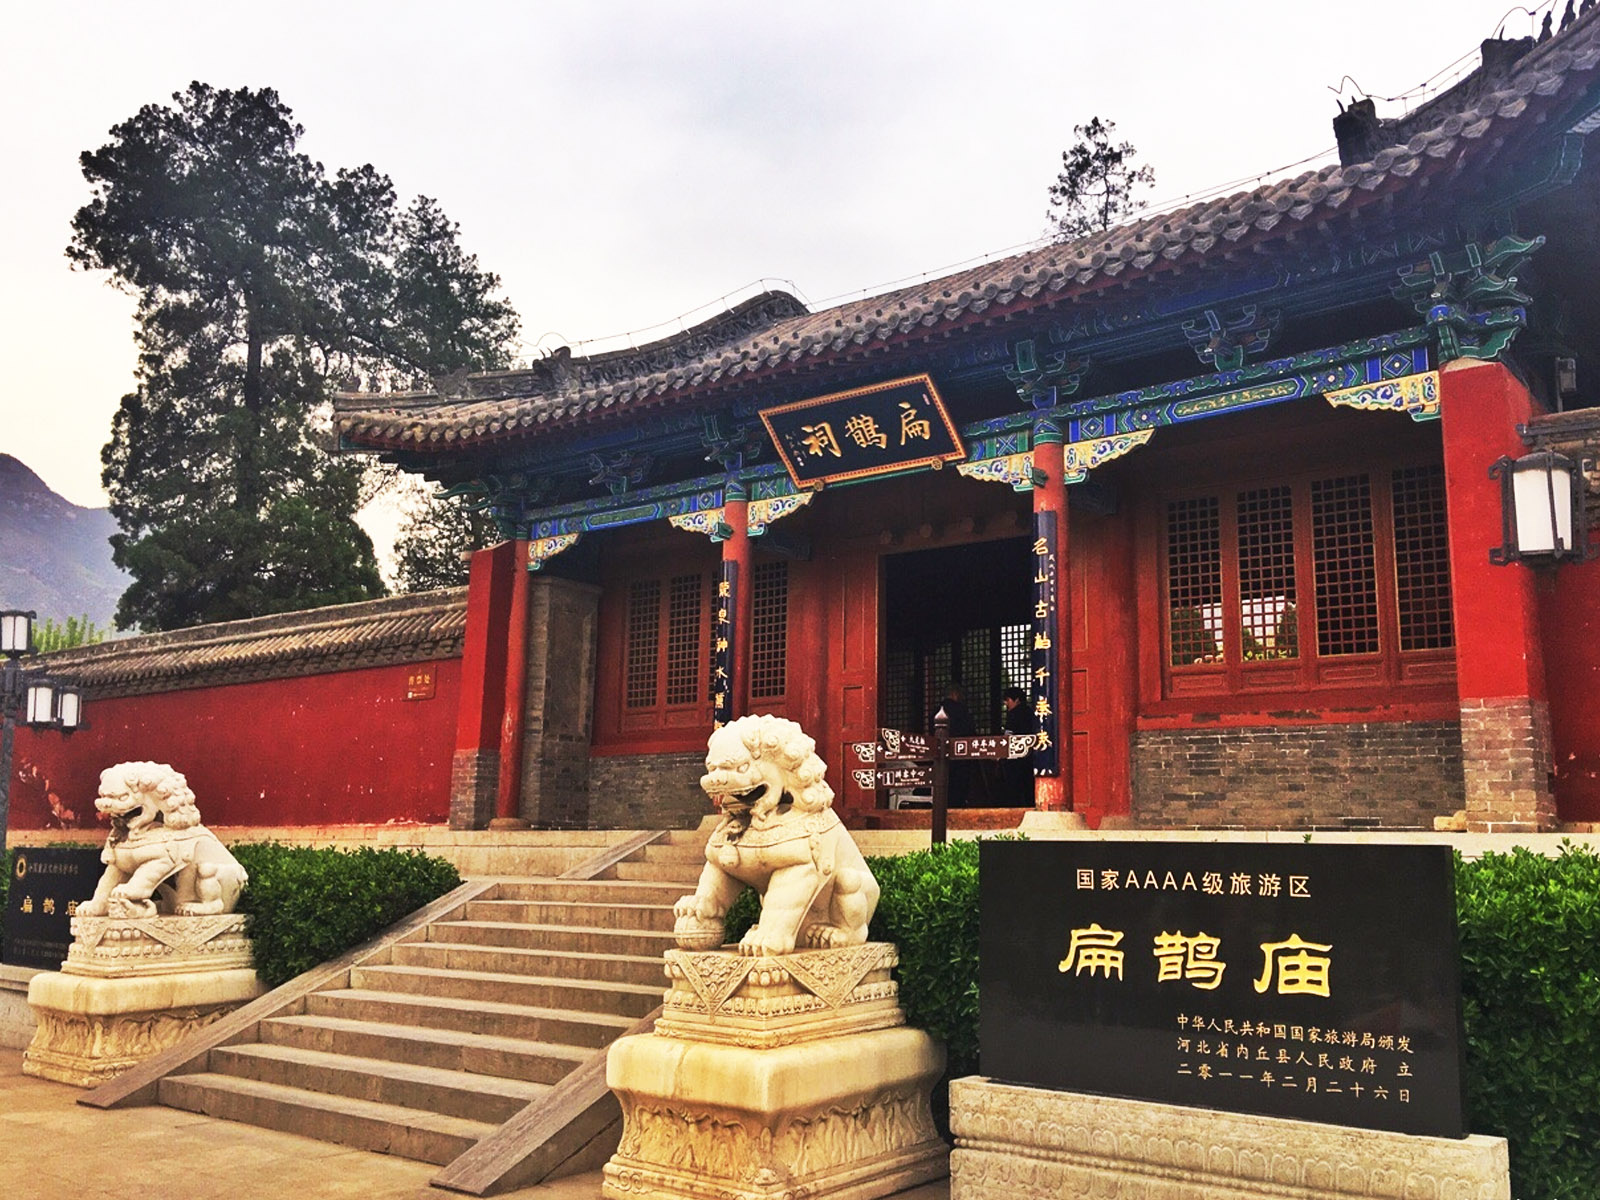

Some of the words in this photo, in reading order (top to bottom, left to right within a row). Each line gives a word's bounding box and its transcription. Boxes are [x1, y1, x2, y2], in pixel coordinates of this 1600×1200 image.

[1076, 868, 1311, 898] 国家AAAA级旅游区
[1058, 923, 1333, 998] 扁鹊庙
[1176, 1013, 1414, 1054] 中华人民共和国国家旅游局颁发
[1176, 1036, 1378, 1075] 河北省内丘县人民政府
[1396, 1061, 1413, 1078] 立
[1176, 1062, 1411, 1104] 二零一一年二月二十六日
